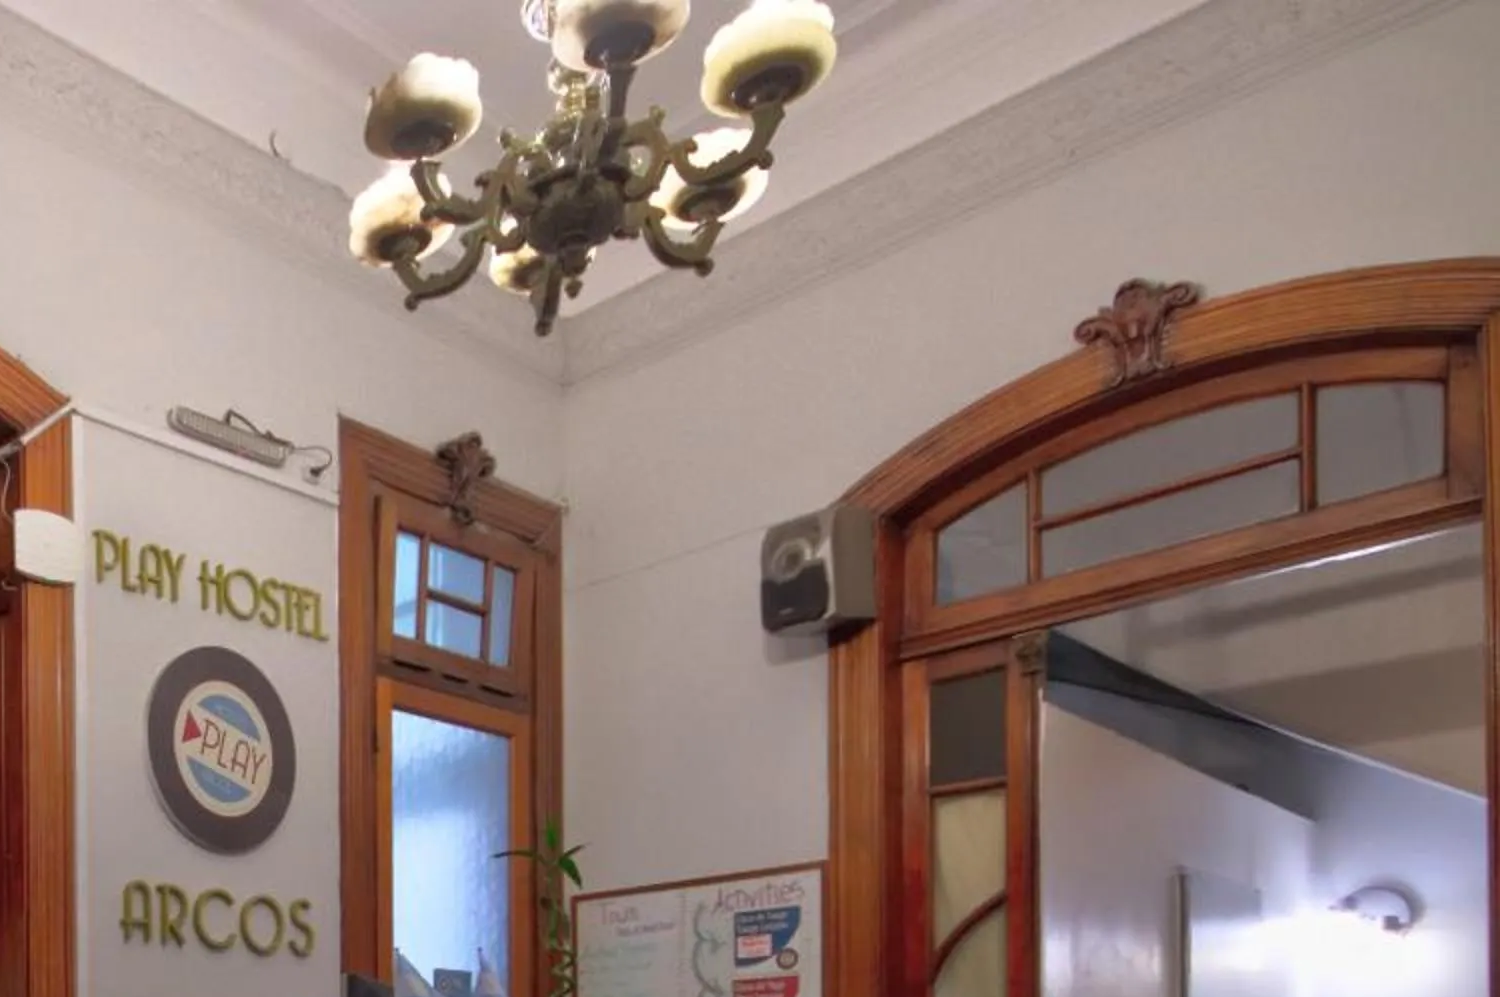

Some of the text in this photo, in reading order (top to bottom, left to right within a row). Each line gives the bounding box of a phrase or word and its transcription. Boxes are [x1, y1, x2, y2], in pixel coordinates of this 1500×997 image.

[92, 529, 329, 642] PLAY HOSTEL
[200, 718, 267, 785] PLAY
[119, 879, 315, 960] ARCOS
